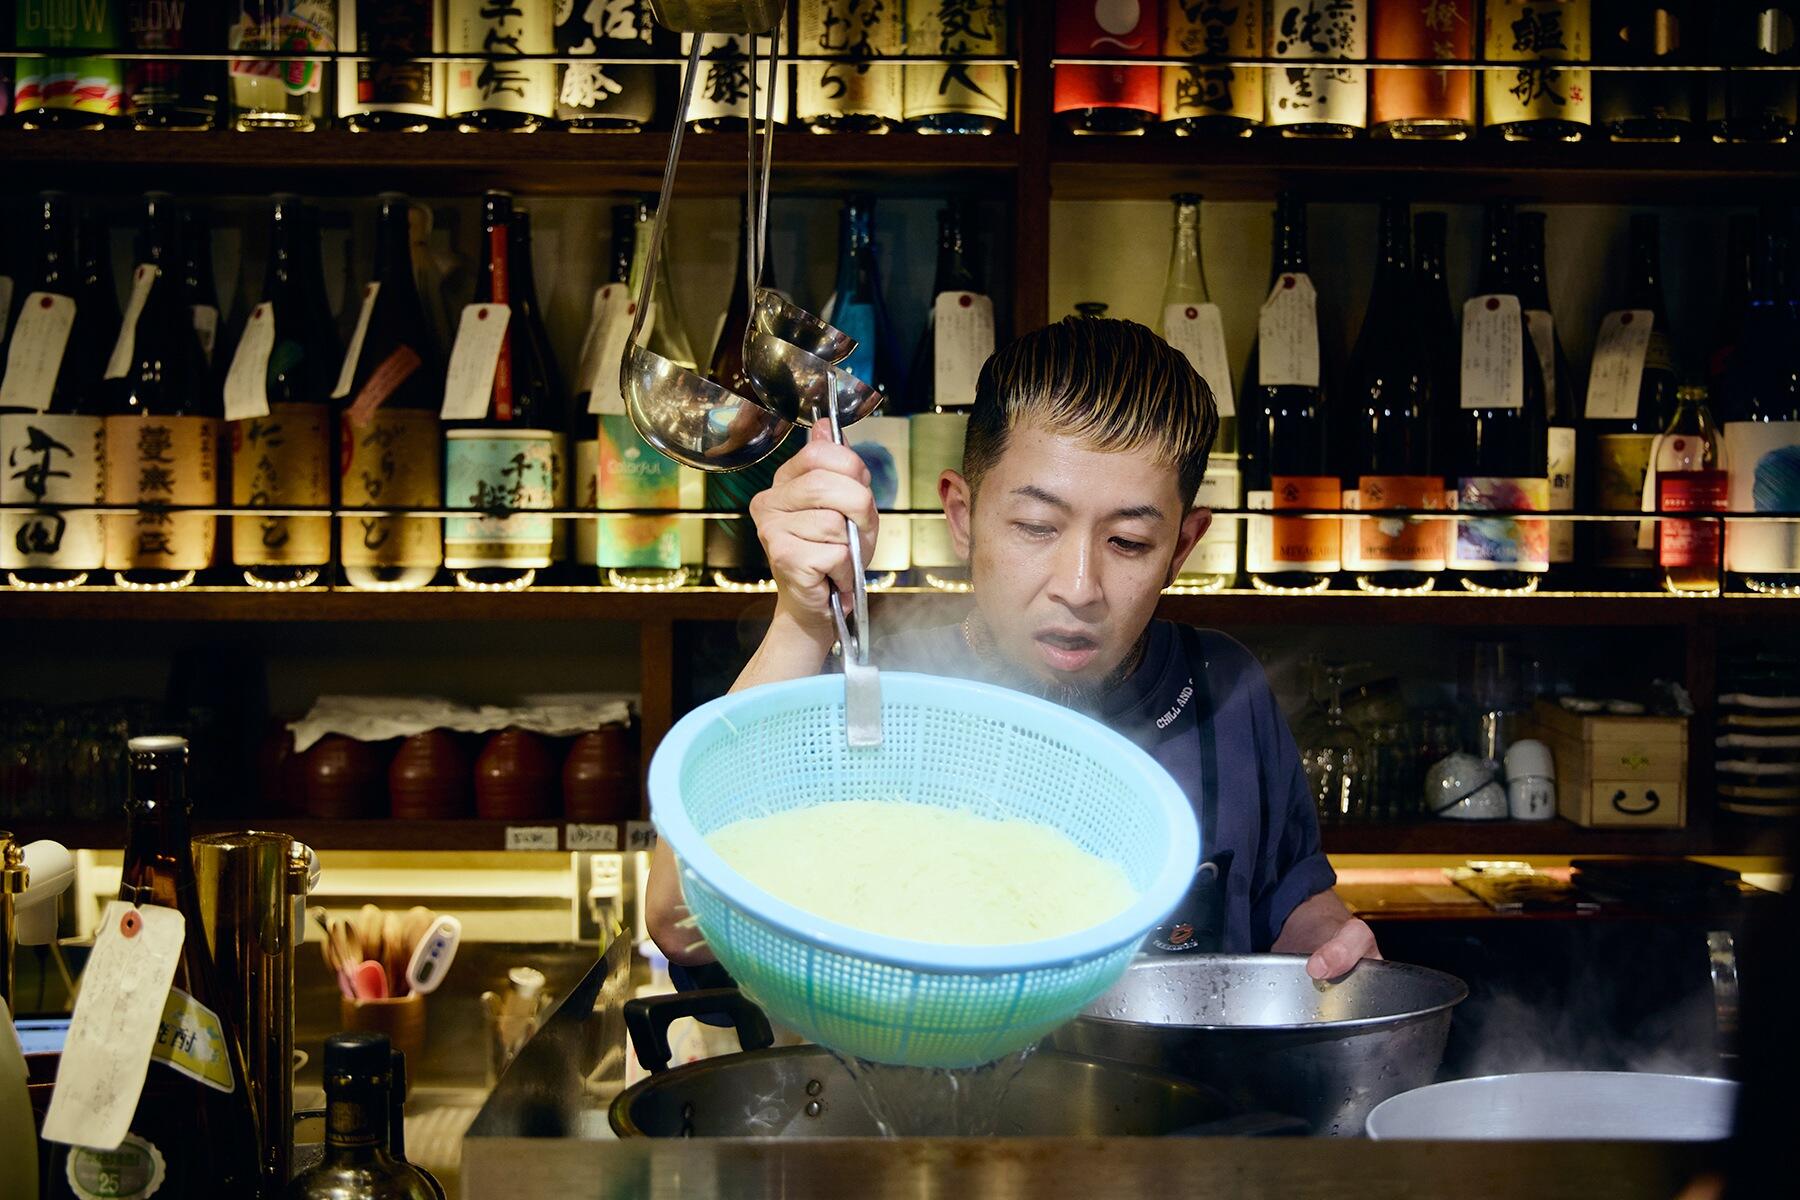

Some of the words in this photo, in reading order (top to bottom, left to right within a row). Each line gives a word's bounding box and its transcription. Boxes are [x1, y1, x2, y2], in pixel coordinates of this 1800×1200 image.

[1156, 706, 1181, 729] CHILL
[1176, 686, 1193, 707] AND
[98, 1172, 120, 1194] 25
